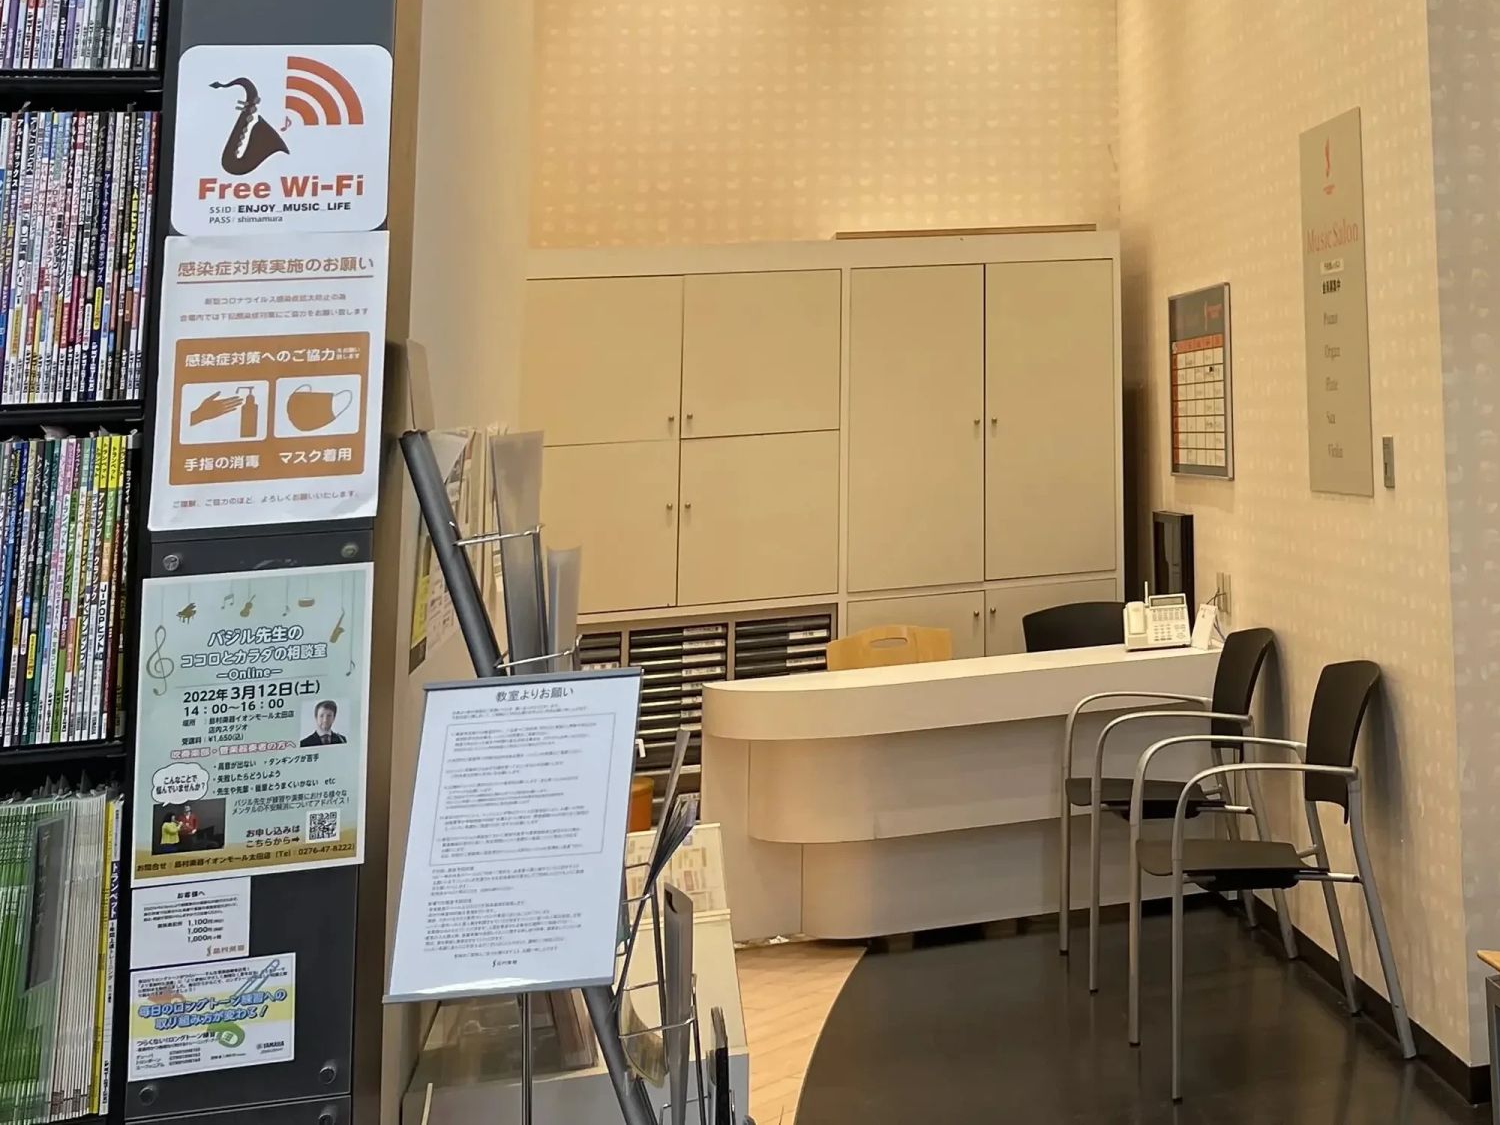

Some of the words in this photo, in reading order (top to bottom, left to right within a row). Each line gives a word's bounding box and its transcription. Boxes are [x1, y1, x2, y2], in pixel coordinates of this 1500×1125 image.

[198, 178, 271, 201] Free
[280, 175, 365, 198] Wi-Fi
[237, 202, 352, 214] ENJOY_MUSIC_LIFE
[237, 215, 283, 224] shimamura
[178, 256, 375, 277] 感染症対策実施のお願い
[185, 348, 336, 368] 感染症対策へのご協力
[183, 454, 260, 472] 手指の消毒
[278, 447, 353, 465] マスク着用
[208, 625, 304, 647] バジル先生の
[180, 642, 328, 668] ココロとカラダの相談室
[495, 686, 575, 703] 教室よりお願い
[324, 777, 336, 786] etc
[246, 825, 300, 839] お申し込みは
[109, 862, 120, 919] トランペット
